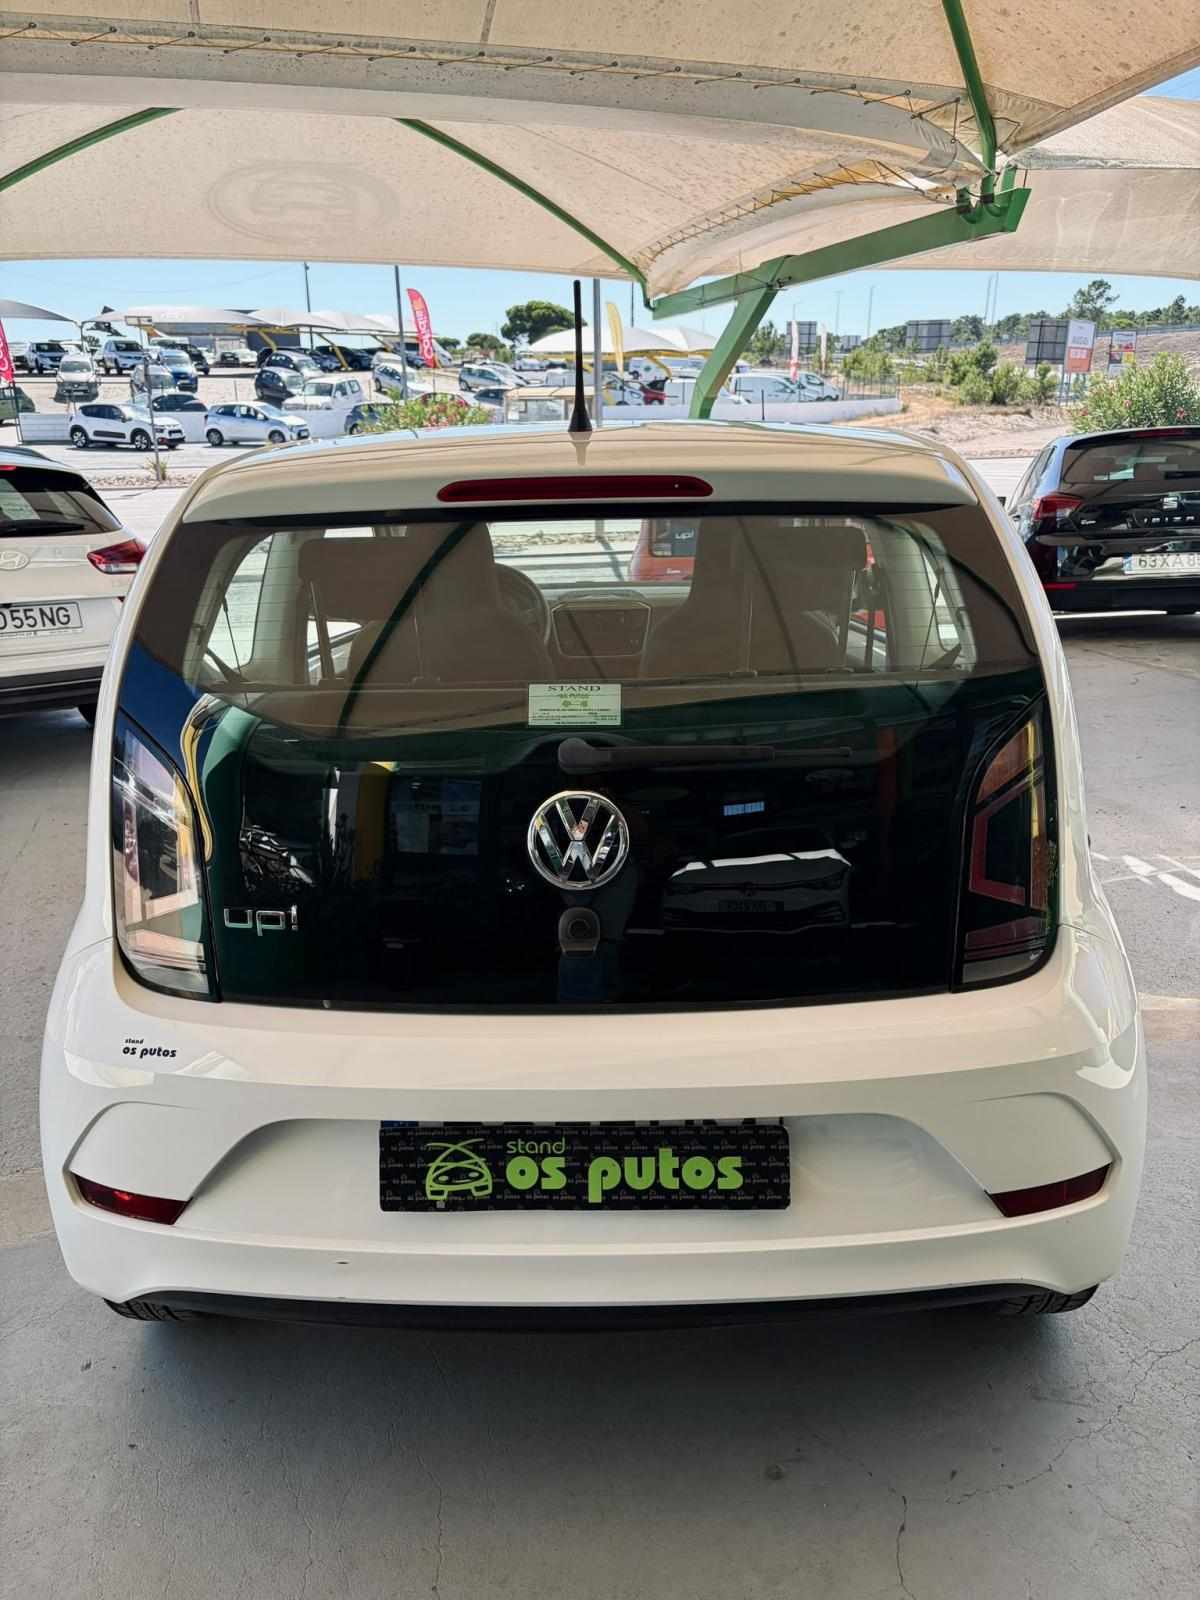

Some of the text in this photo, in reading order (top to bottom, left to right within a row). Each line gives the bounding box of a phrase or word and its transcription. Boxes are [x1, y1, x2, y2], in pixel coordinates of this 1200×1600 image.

[223, 903, 299, 937] up!
[122, 1046, 177, 1059] os putos
[506, 1137, 566, 1154] stand
[505, 1147, 744, 1203] os putos
